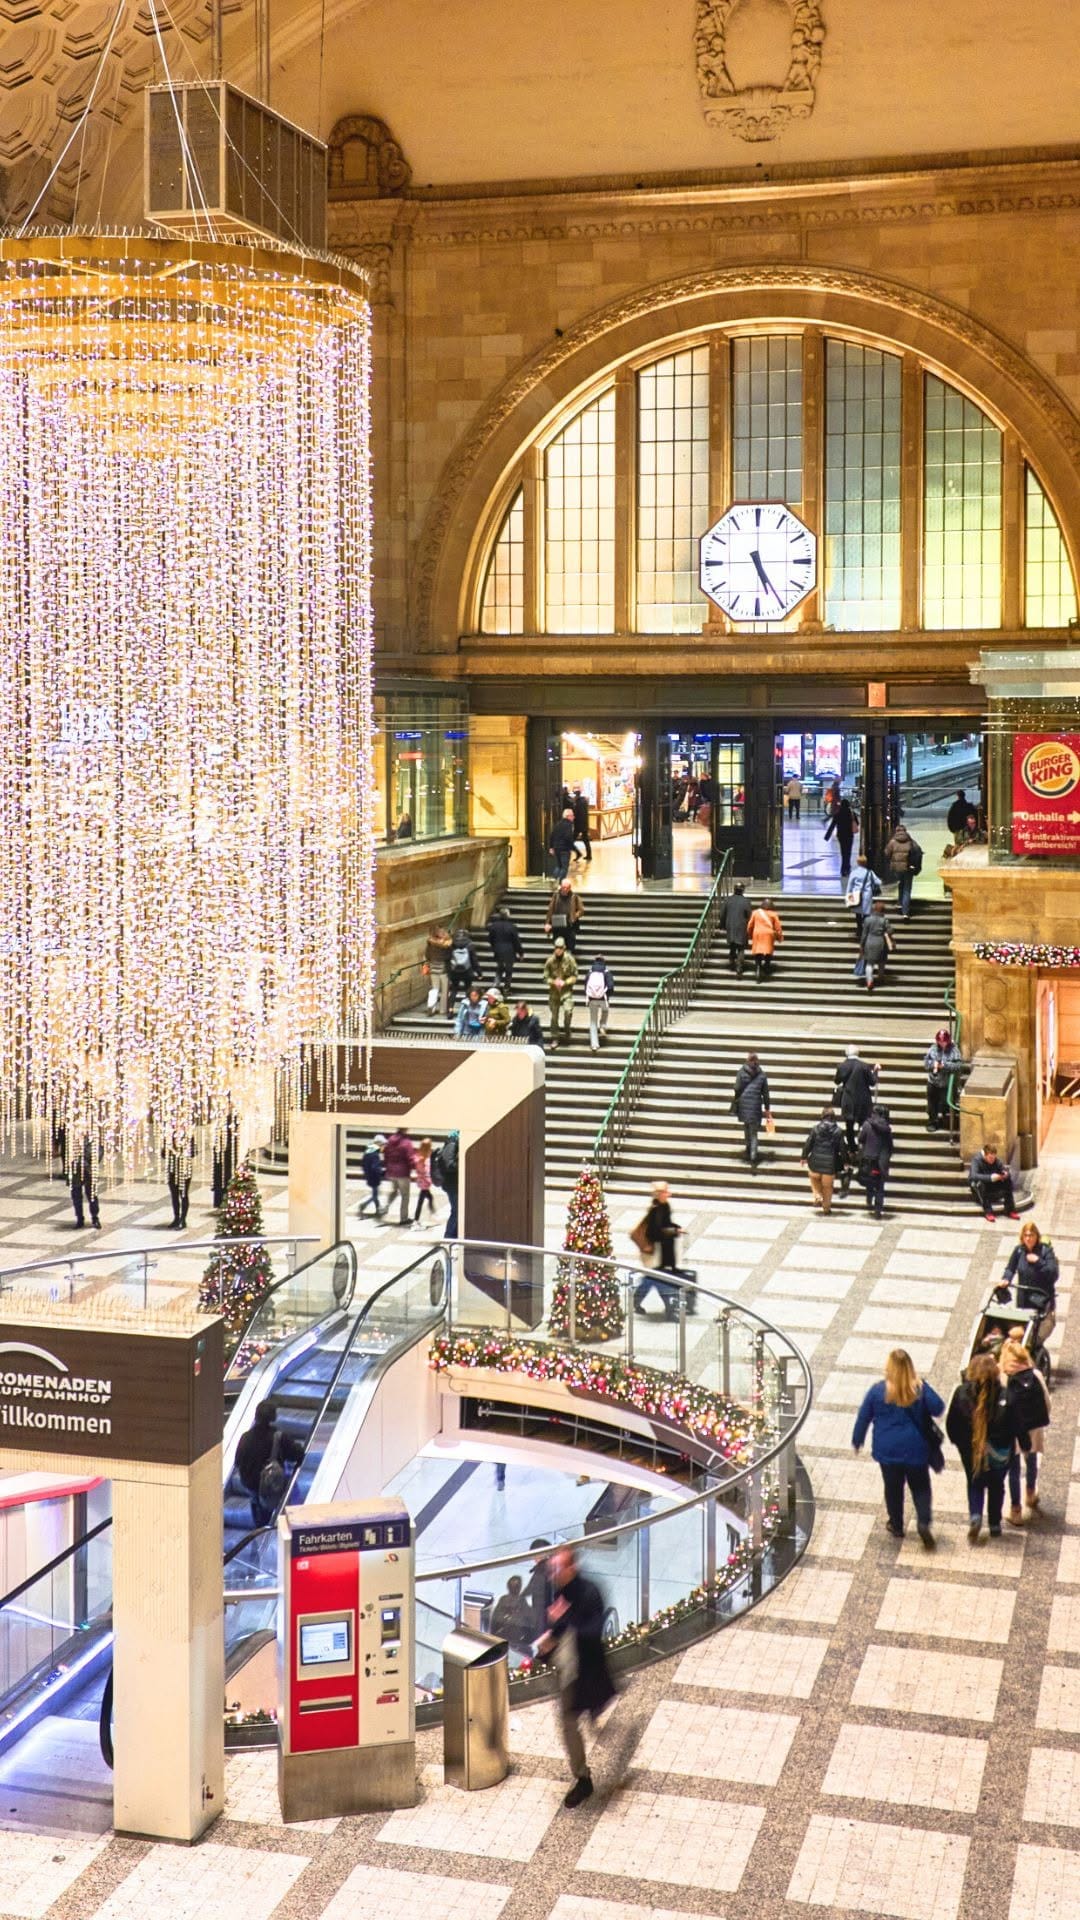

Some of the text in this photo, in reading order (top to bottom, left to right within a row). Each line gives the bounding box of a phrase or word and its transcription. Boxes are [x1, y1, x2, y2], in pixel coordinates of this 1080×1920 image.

[1029, 753, 1071, 772] BURGER
[1031, 762, 1073, 785] KING
[1022, 811, 1065, 821] Osthalle
[339, 1083, 358, 1091] Aes
[373, 1084, 399, 1094] Reisen,
[361, 1095, 376, 1103] und
[376, 1095, 411, 1104] Genießen
[0, 1404, 112, 1435] illkommen
[299, 1532, 353, 1545] Fahrkarten
